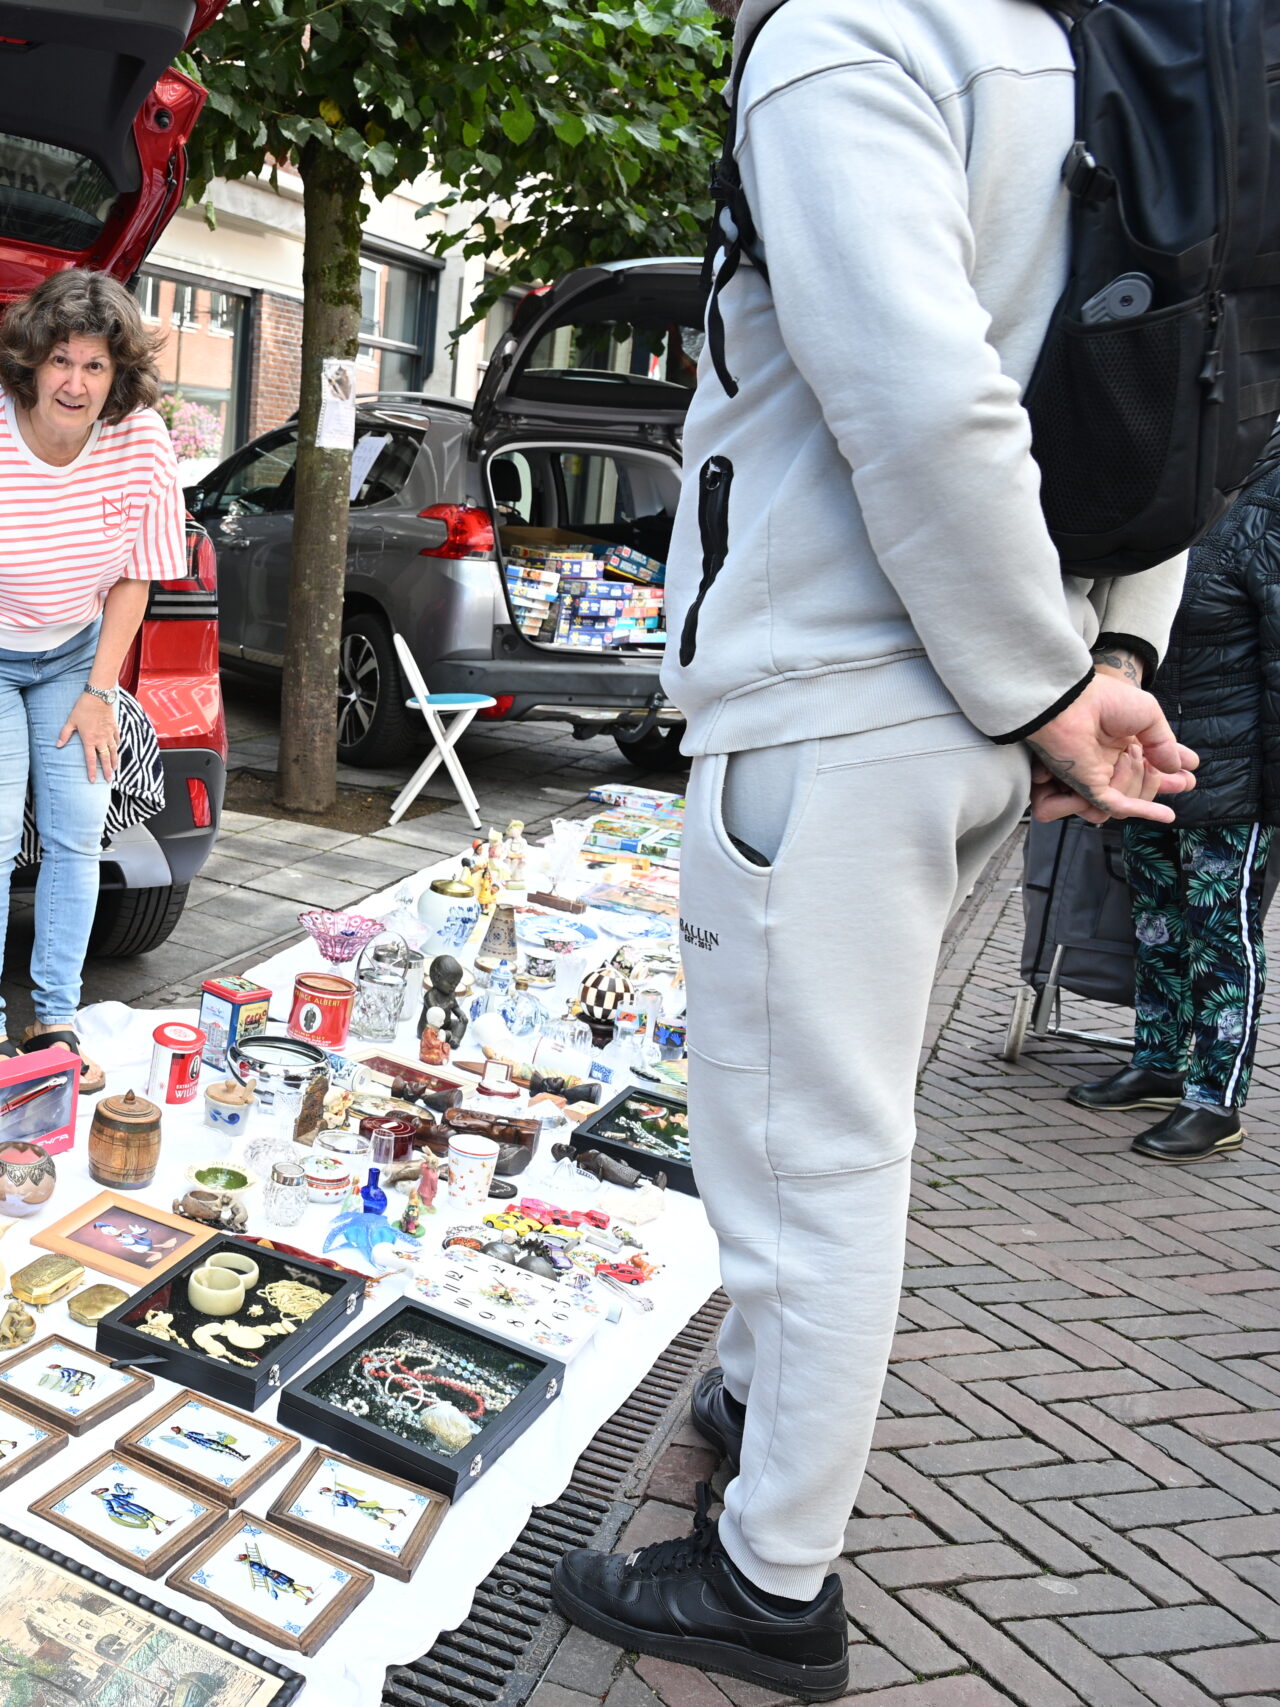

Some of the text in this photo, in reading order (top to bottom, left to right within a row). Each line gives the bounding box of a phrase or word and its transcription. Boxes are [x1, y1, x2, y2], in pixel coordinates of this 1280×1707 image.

[680, 918, 719, 946] BALLIN
[314, 998, 341, 1007] ALBERT
[463, 1265, 479, 1273] 1
[488, 1264, 506, 1274] 2
[444, 1269, 464, 1282] 12
[516, 1271, 534, 1281] 3
[442, 1283, 461, 1293] 11
[540, 1284, 556, 1294] 4
[454, 1297, 473, 1309] 10
[553, 1298, 571, 1308] 5
[478, 1311, 496, 1321] 9
[551, 1311, 569, 1321] 6
[506, 1319, 525, 1328] 8
[534, 1319, 551, 1330] 7
